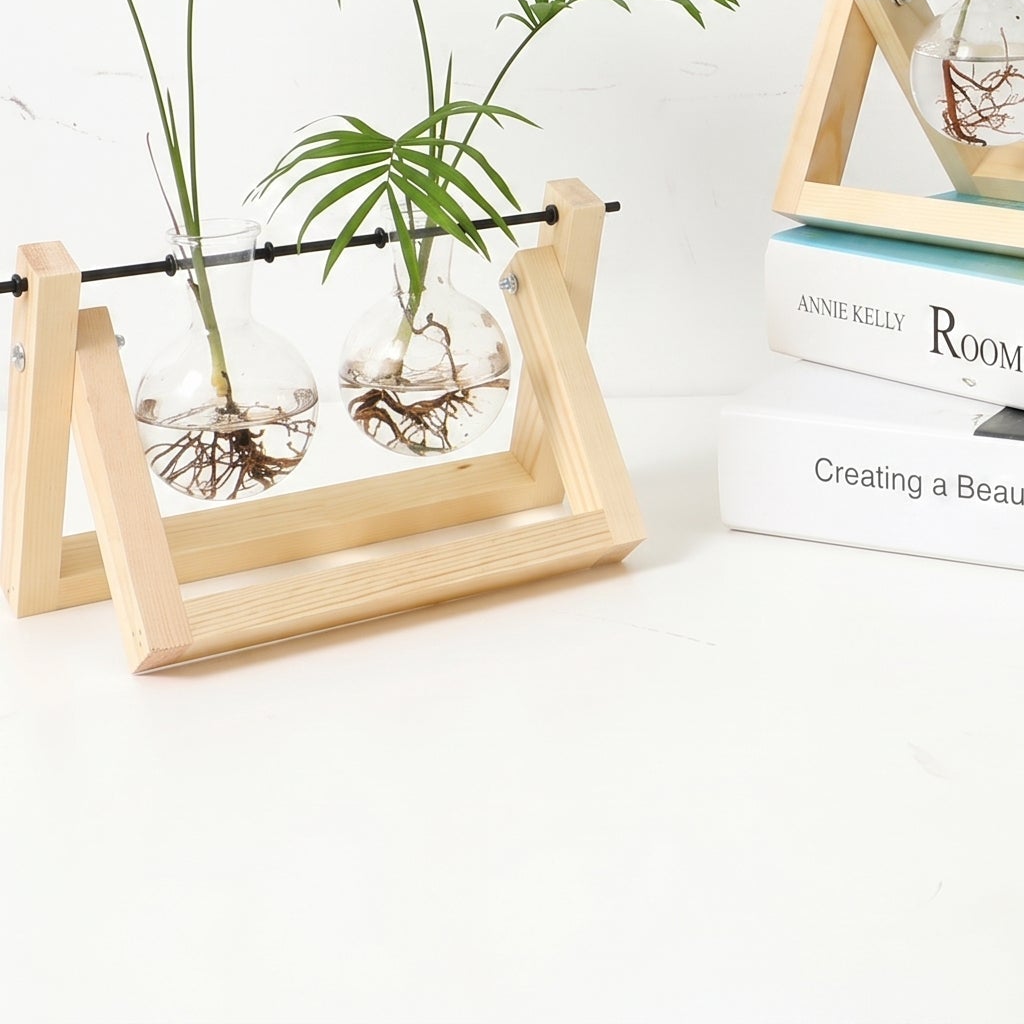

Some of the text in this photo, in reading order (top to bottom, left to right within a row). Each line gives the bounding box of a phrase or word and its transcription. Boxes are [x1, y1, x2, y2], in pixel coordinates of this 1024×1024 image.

[797, 294, 906, 332] ANNIE KELLY
[814, 457, 922, 500] Creating
[932, 477, 948, 497] a
